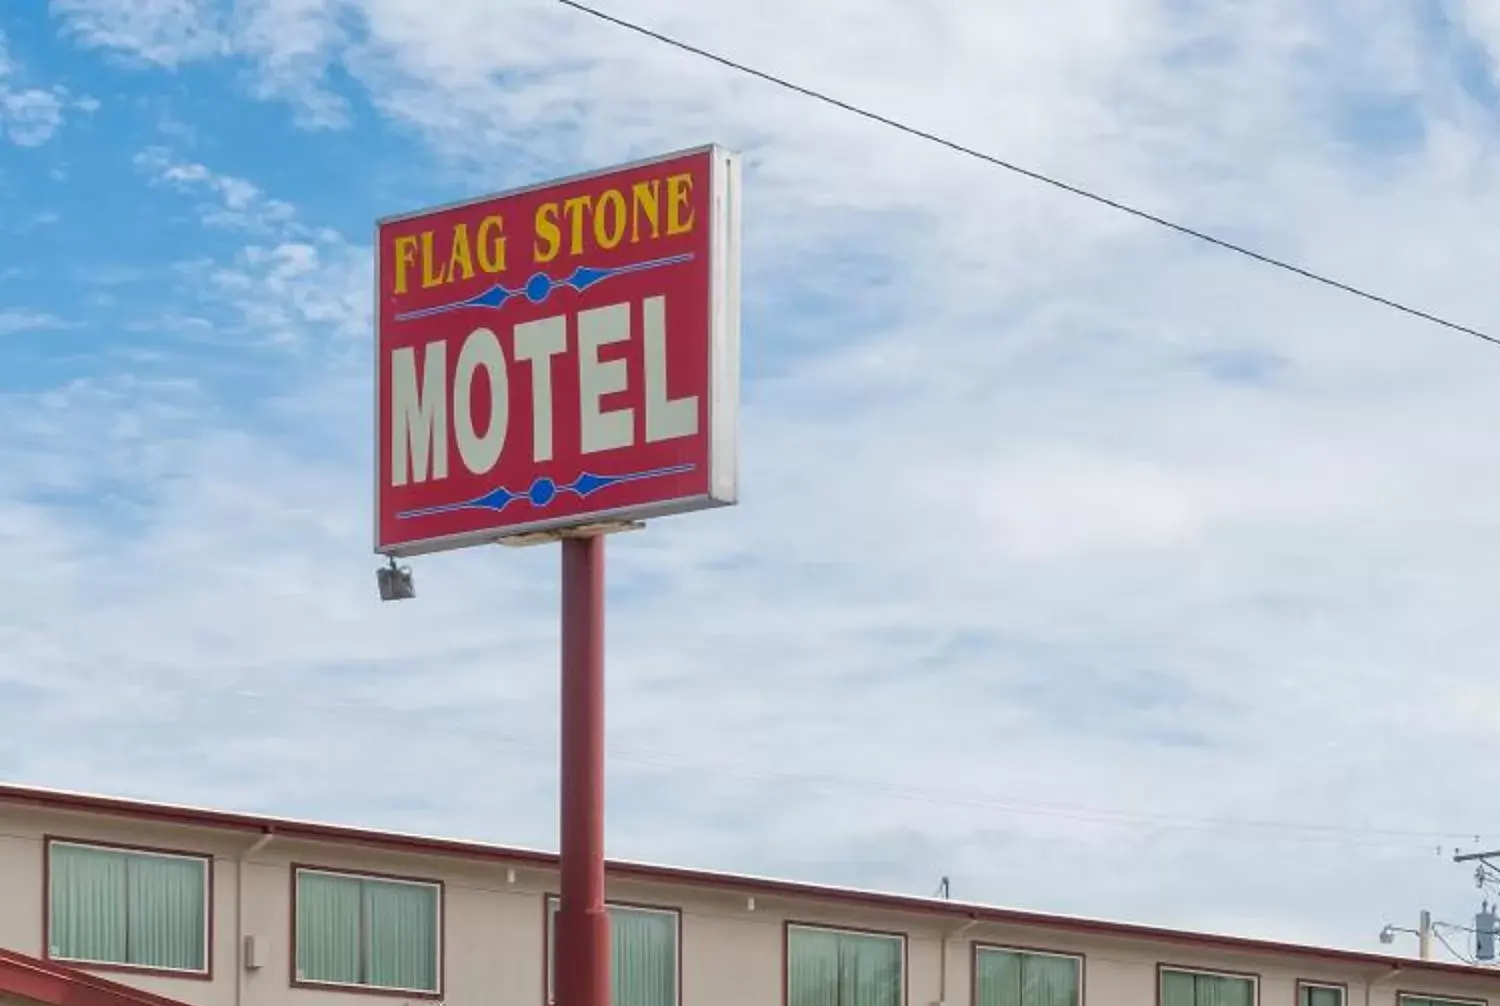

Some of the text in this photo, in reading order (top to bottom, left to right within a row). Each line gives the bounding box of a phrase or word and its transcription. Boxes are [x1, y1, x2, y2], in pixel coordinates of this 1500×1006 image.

[394, 174, 694, 293] FLAG STONE
[391, 295, 699, 487] MOTEL
